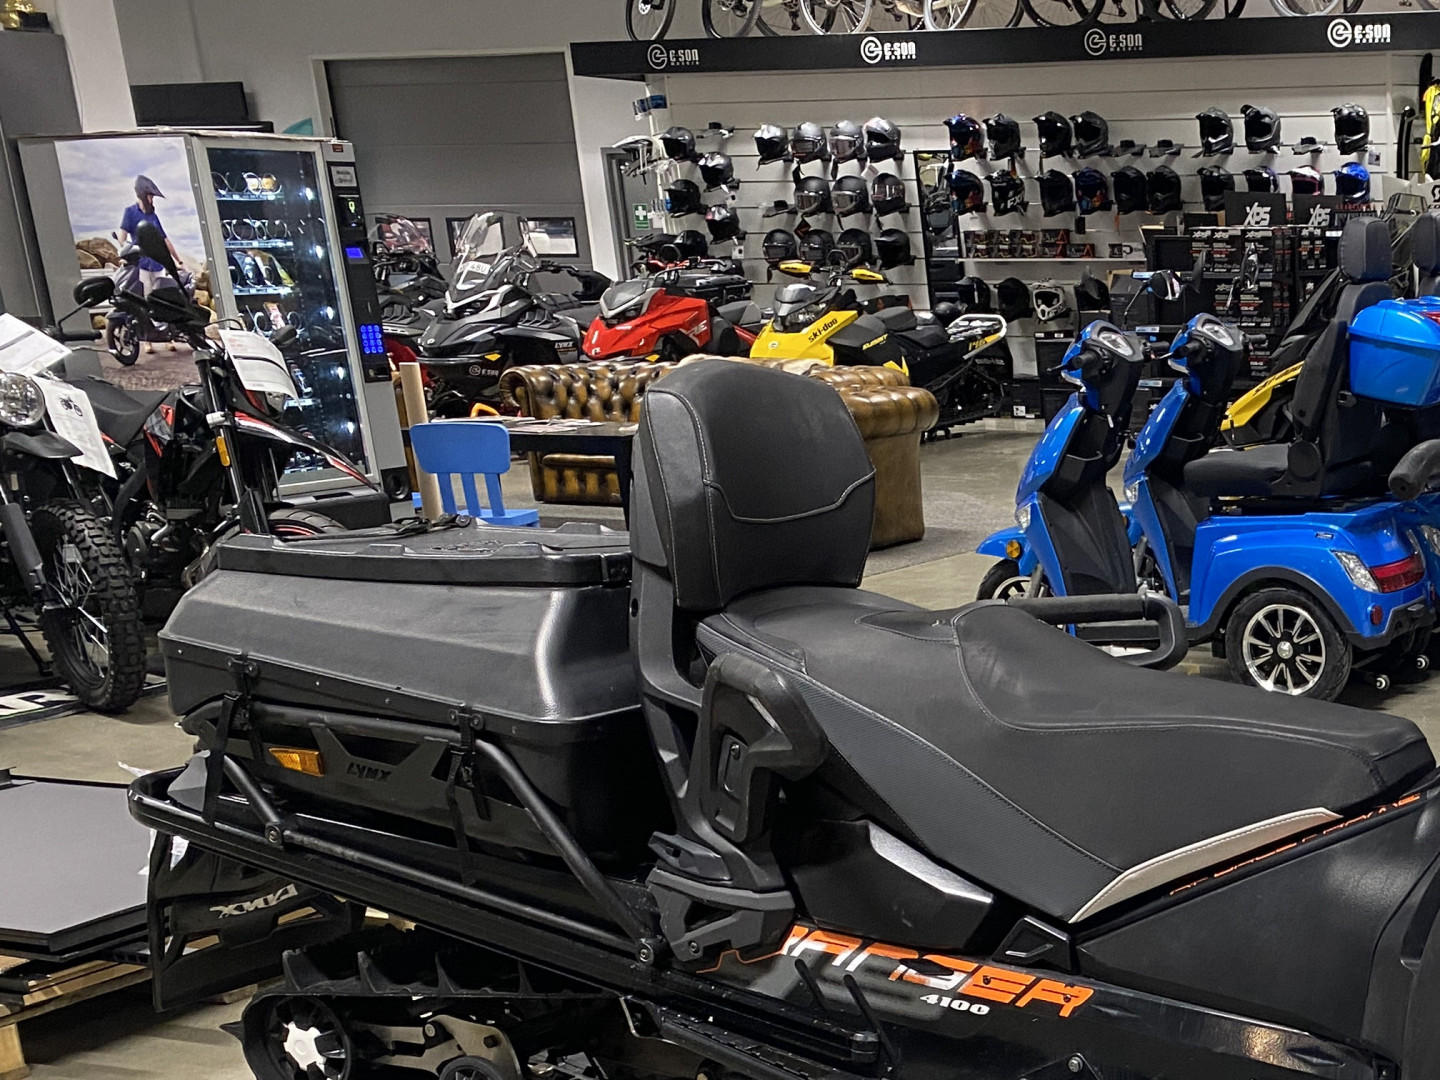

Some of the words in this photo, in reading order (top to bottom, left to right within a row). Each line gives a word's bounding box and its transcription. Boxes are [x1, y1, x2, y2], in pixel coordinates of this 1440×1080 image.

[1243, 202, 1271, 226] XPS
[1308, 204, 1331, 226] XPS
[347, 762, 392, 782] LYNX
[919, 993, 991, 1015] 4100
